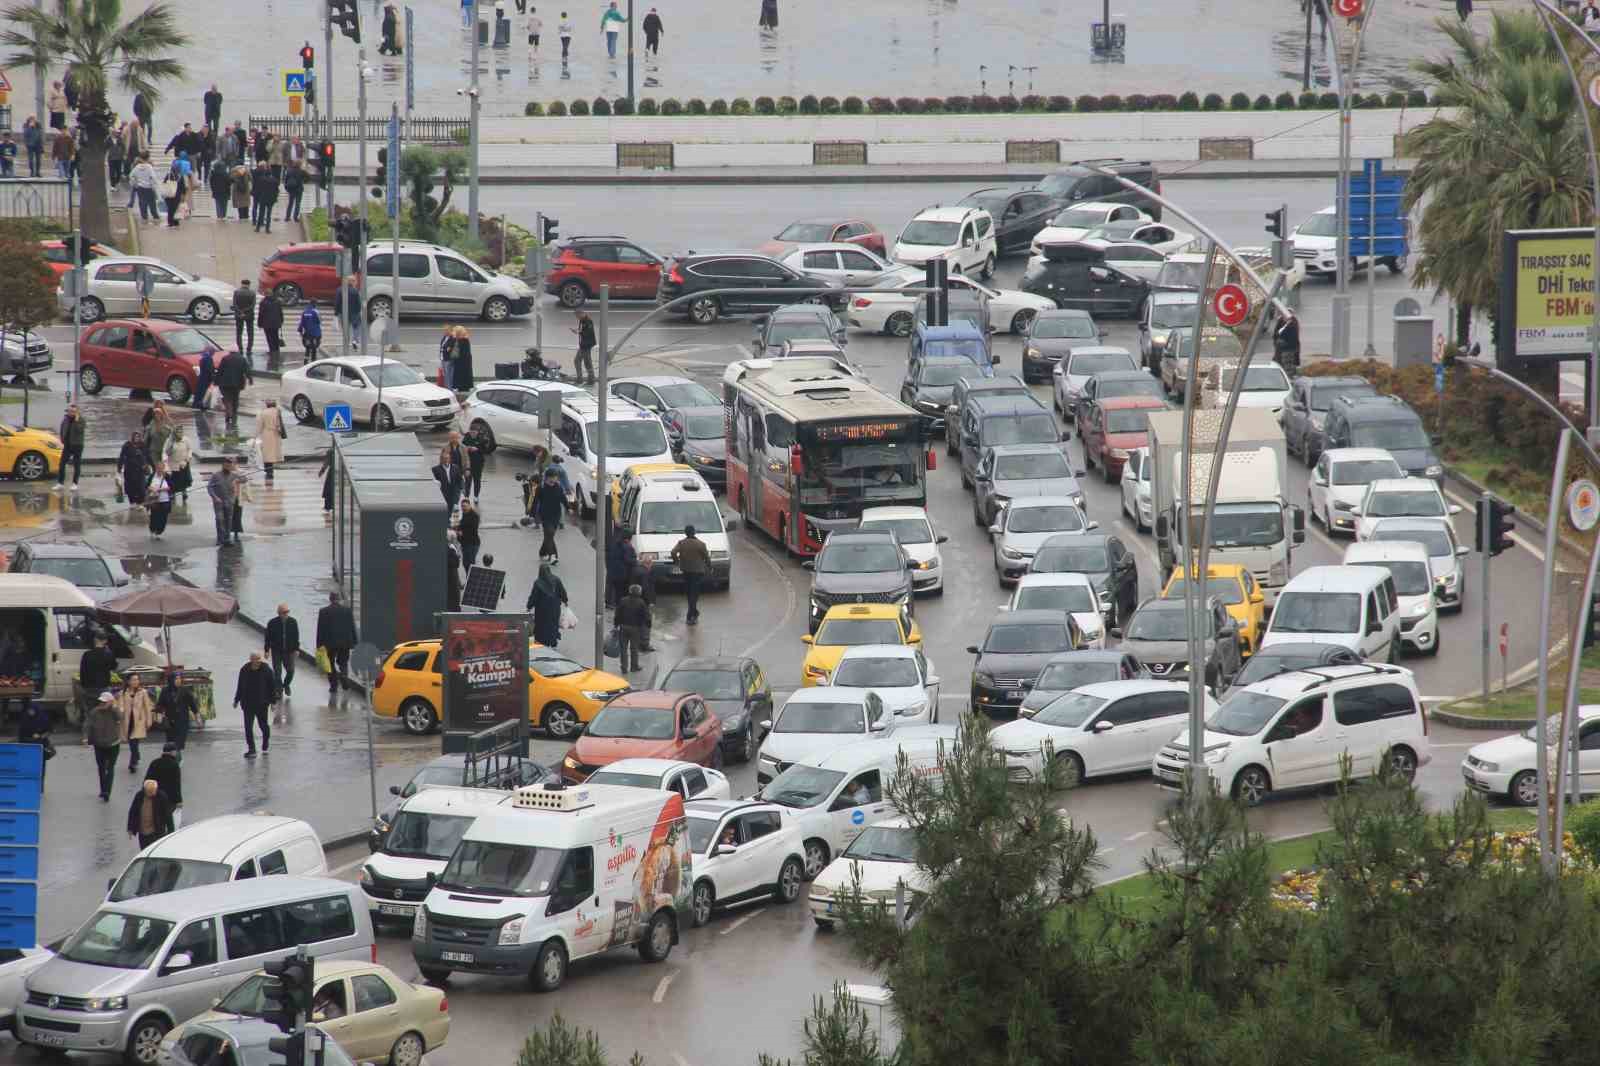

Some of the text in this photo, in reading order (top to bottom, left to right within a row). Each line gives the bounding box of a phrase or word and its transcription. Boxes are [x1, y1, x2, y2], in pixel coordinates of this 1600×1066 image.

[1520, 253, 1591, 271] TIRAŞSIZ SAÇ
[1538, 271, 1564, 294] DHİ
[487, 659, 512, 673] Yaz
[607, 844, 637, 873] aspilic
